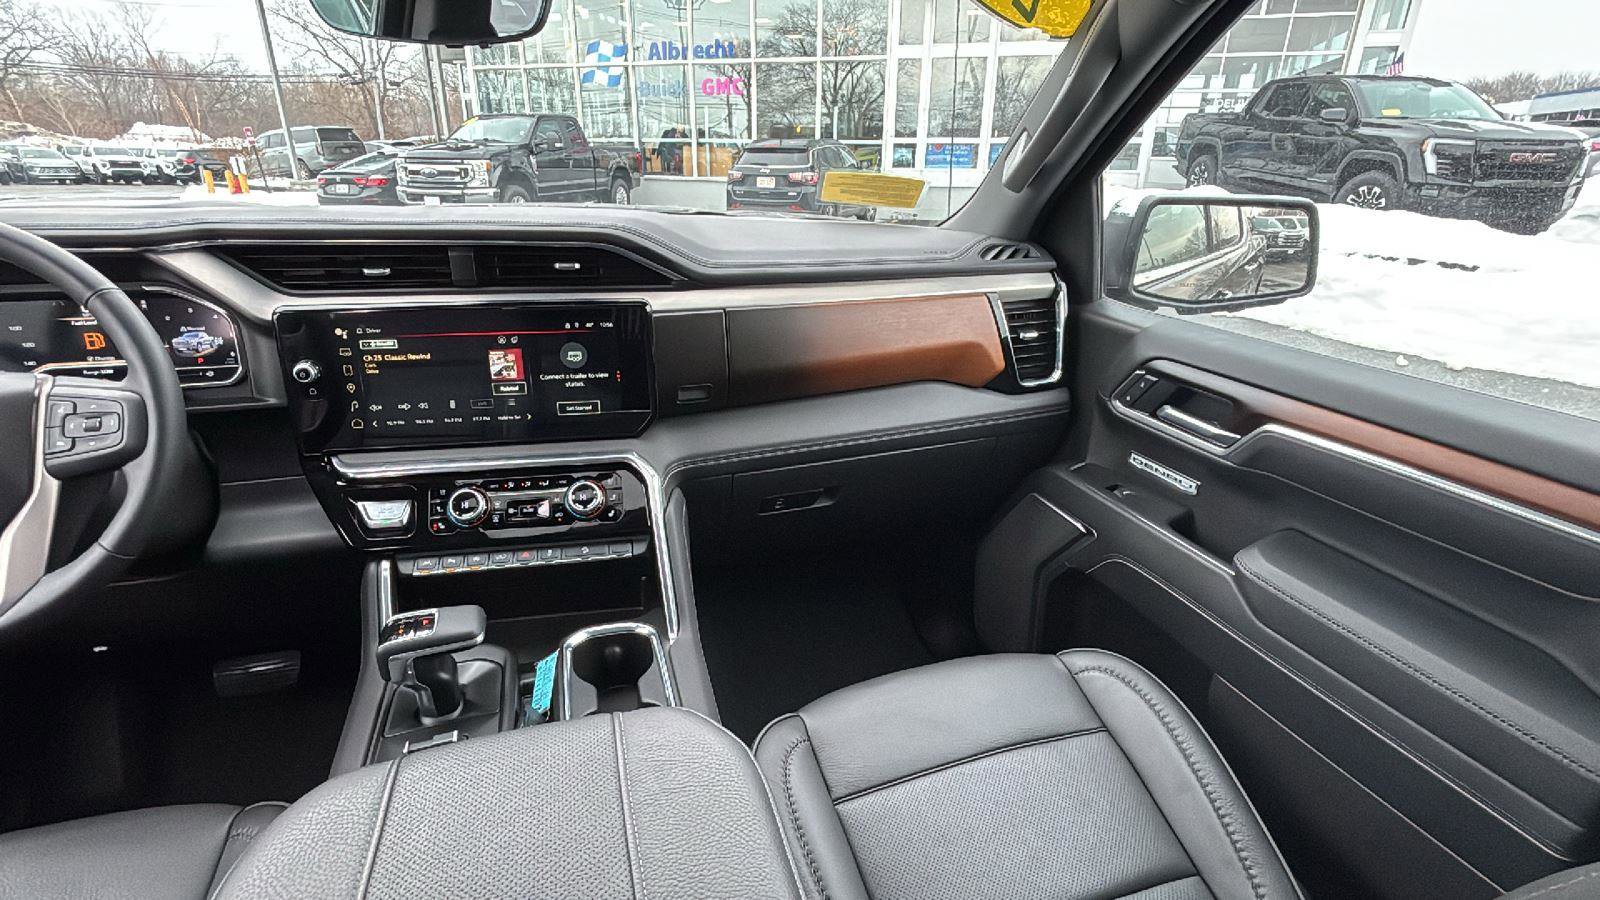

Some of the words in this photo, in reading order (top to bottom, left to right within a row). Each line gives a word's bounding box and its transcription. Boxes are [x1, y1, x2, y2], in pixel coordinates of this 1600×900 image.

[648, 38, 735, 61] Albrecht
[701, 77, 744, 96] GMC
[1509, 152, 1557, 163] GMC
[373, 353, 382, 361] 25
[384, 353, 407, 361] Classic
[407, 352, 431, 360] Rewind
[539, 372, 565, 381] Connect
[570, 371, 588, 380] trailer
[596, 370, 609, 378] view
[1131, 455, 1194, 490] DENALI
